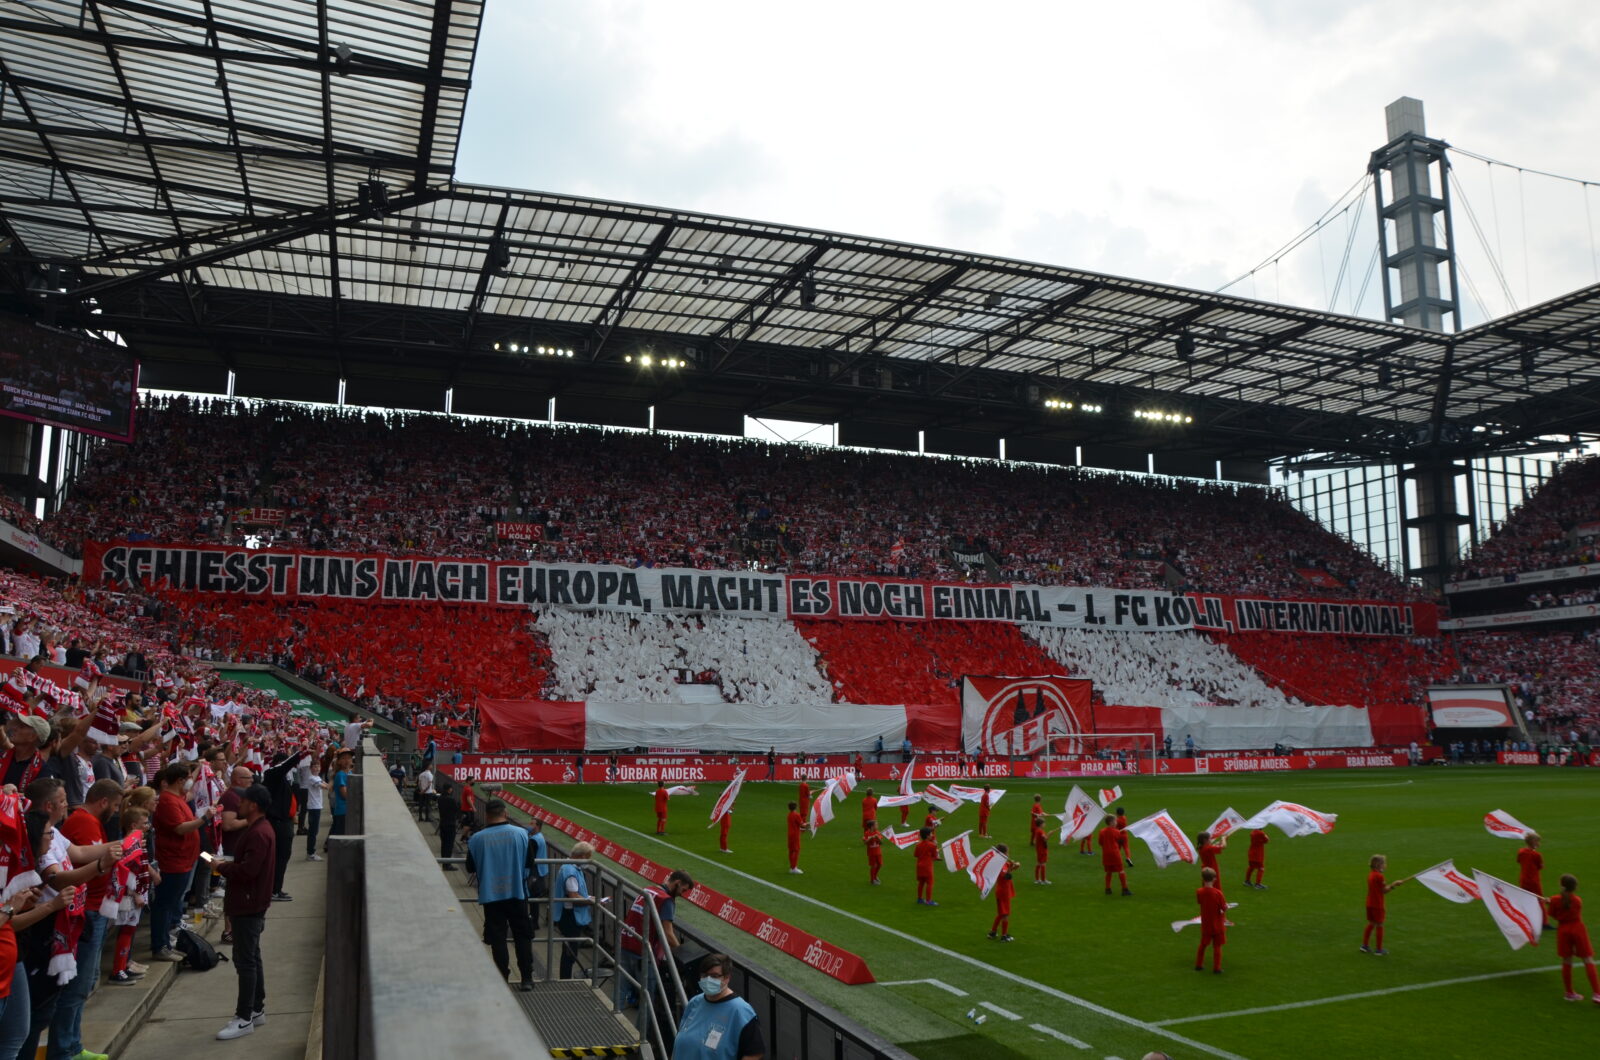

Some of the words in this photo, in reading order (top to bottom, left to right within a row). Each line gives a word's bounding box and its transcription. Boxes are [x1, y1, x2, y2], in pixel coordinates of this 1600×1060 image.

[496, 522, 542, 537] HAWKS
[508, 532, 531, 540] KÖLN
[952, 551, 985, 564] TROIKA
[103, 547, 294, 595] SCHIESST
[298, 554, 378, 599] UNS
[382, 558, 488, 602] NACH
[497, 565, 652, 612] EUROPA,
[660, 574, 783, 612] MACHT
[790, 579, 832, 615] ES
[838, 580, 925, 617] NOCH
[932, 585, 1052, 622] EINMAL
[1084, 593, 1107, 625] 1.
[1114, 594, 1149, 626] FC
[1153, 592, 1235, 634] KÖLN,
[1234, 598, 1414, 635] INTERNATIONAL!
[1223, 757, 1259, 771] SPÜRBAR
[1260, 758, 1292, 770] ANDERS.
[484, 767, 534, 781] ANDERS.
[660, 767, 707, 780] ANDERS.
[718, 903, 746, 926] DERTOUR
[756, 921, 789, 950] DERTOUR
[803, 943, 843, 976] DERTOUR
